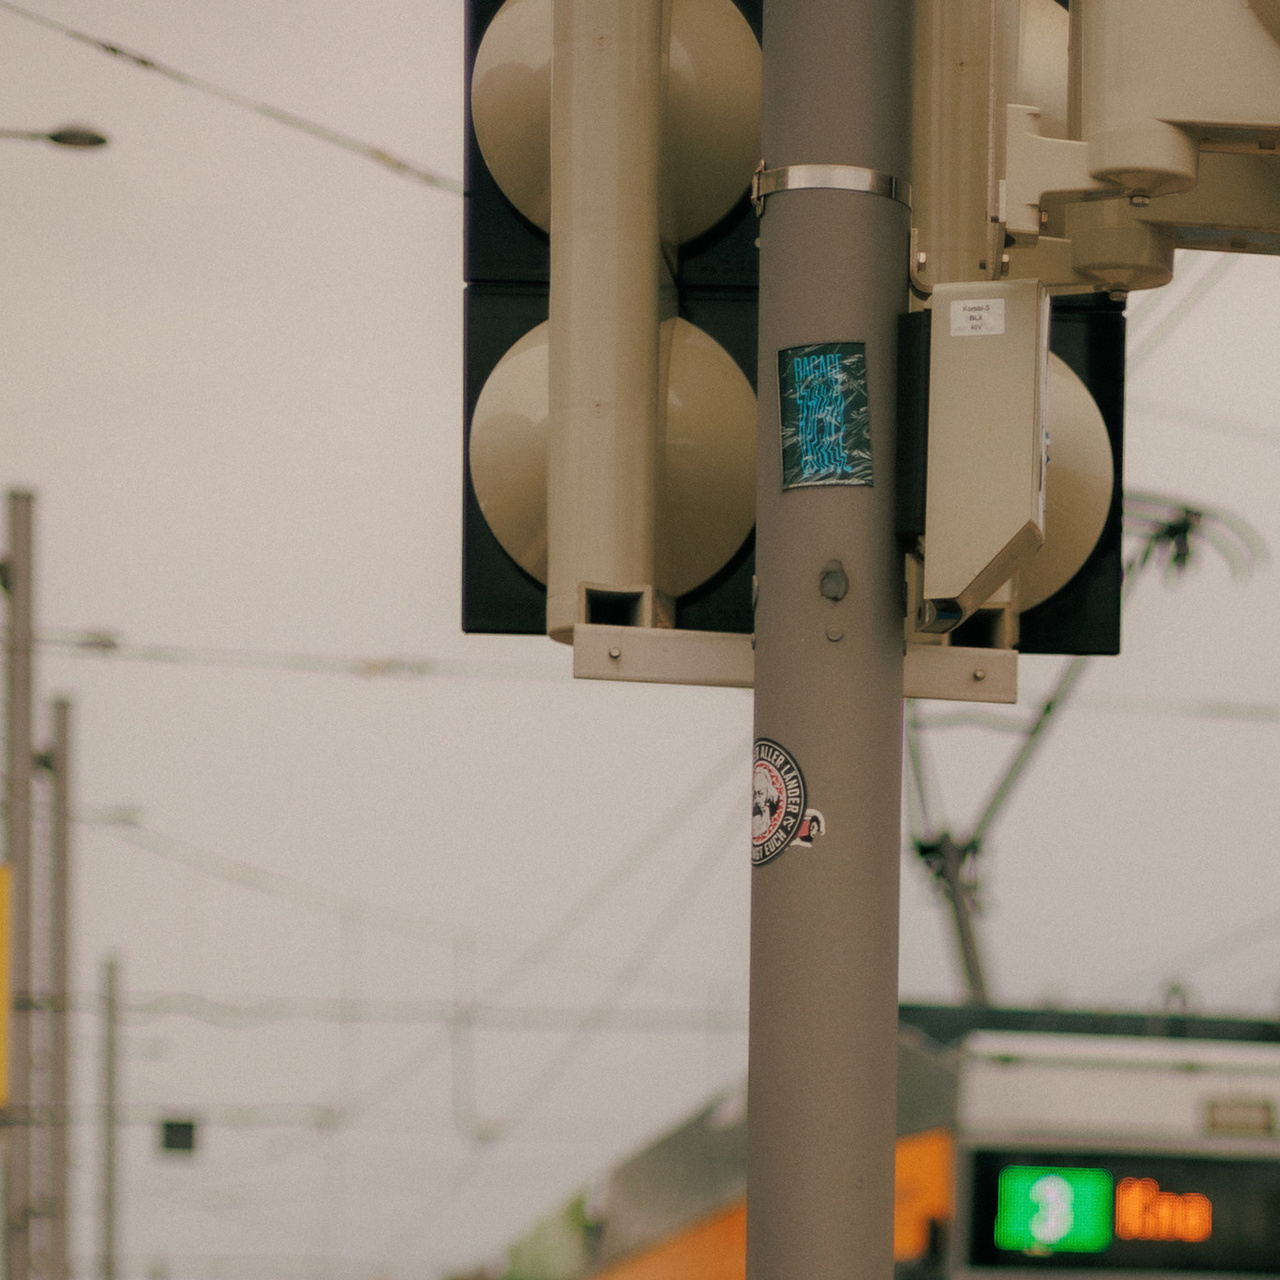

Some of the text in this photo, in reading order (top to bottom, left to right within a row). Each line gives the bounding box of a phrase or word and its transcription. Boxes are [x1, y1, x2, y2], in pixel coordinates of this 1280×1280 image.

[760, 745, 800, 813] ALLER LÄNDER
[765, 829, 787, 858] EUCH
[1029, 1174, 1074, 1243] 3
